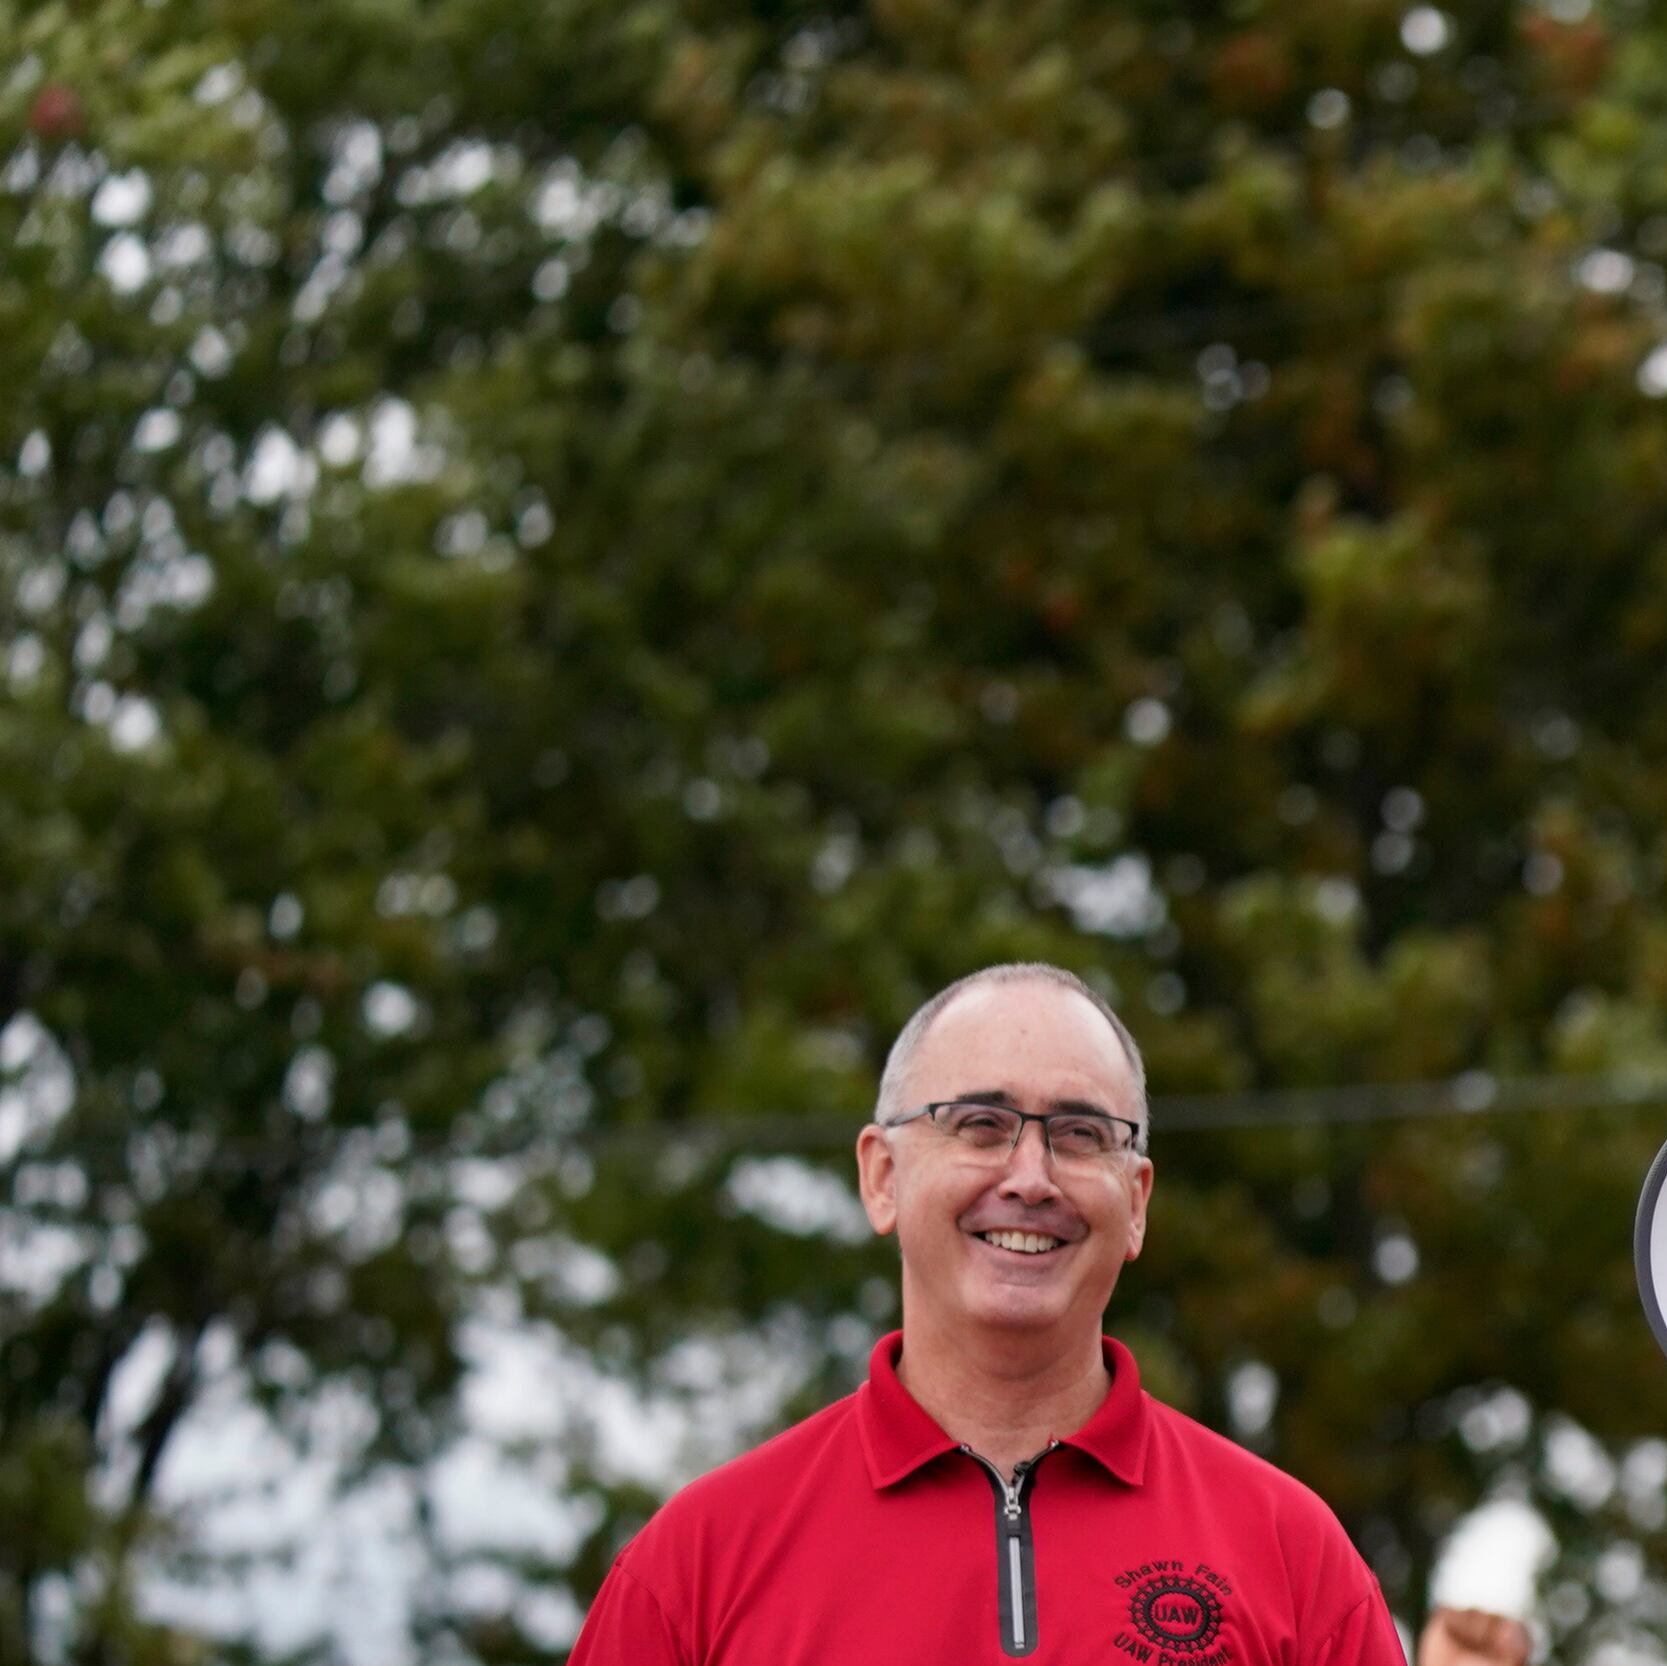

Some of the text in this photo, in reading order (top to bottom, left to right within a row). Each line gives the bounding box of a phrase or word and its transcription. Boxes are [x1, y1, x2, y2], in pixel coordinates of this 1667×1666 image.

[1114, 1559, 1233, 1597] Shawn Fain
[1154, 1606, 1199, 1625] UAW
[1113, 1632, 1153, 1664] UAW
